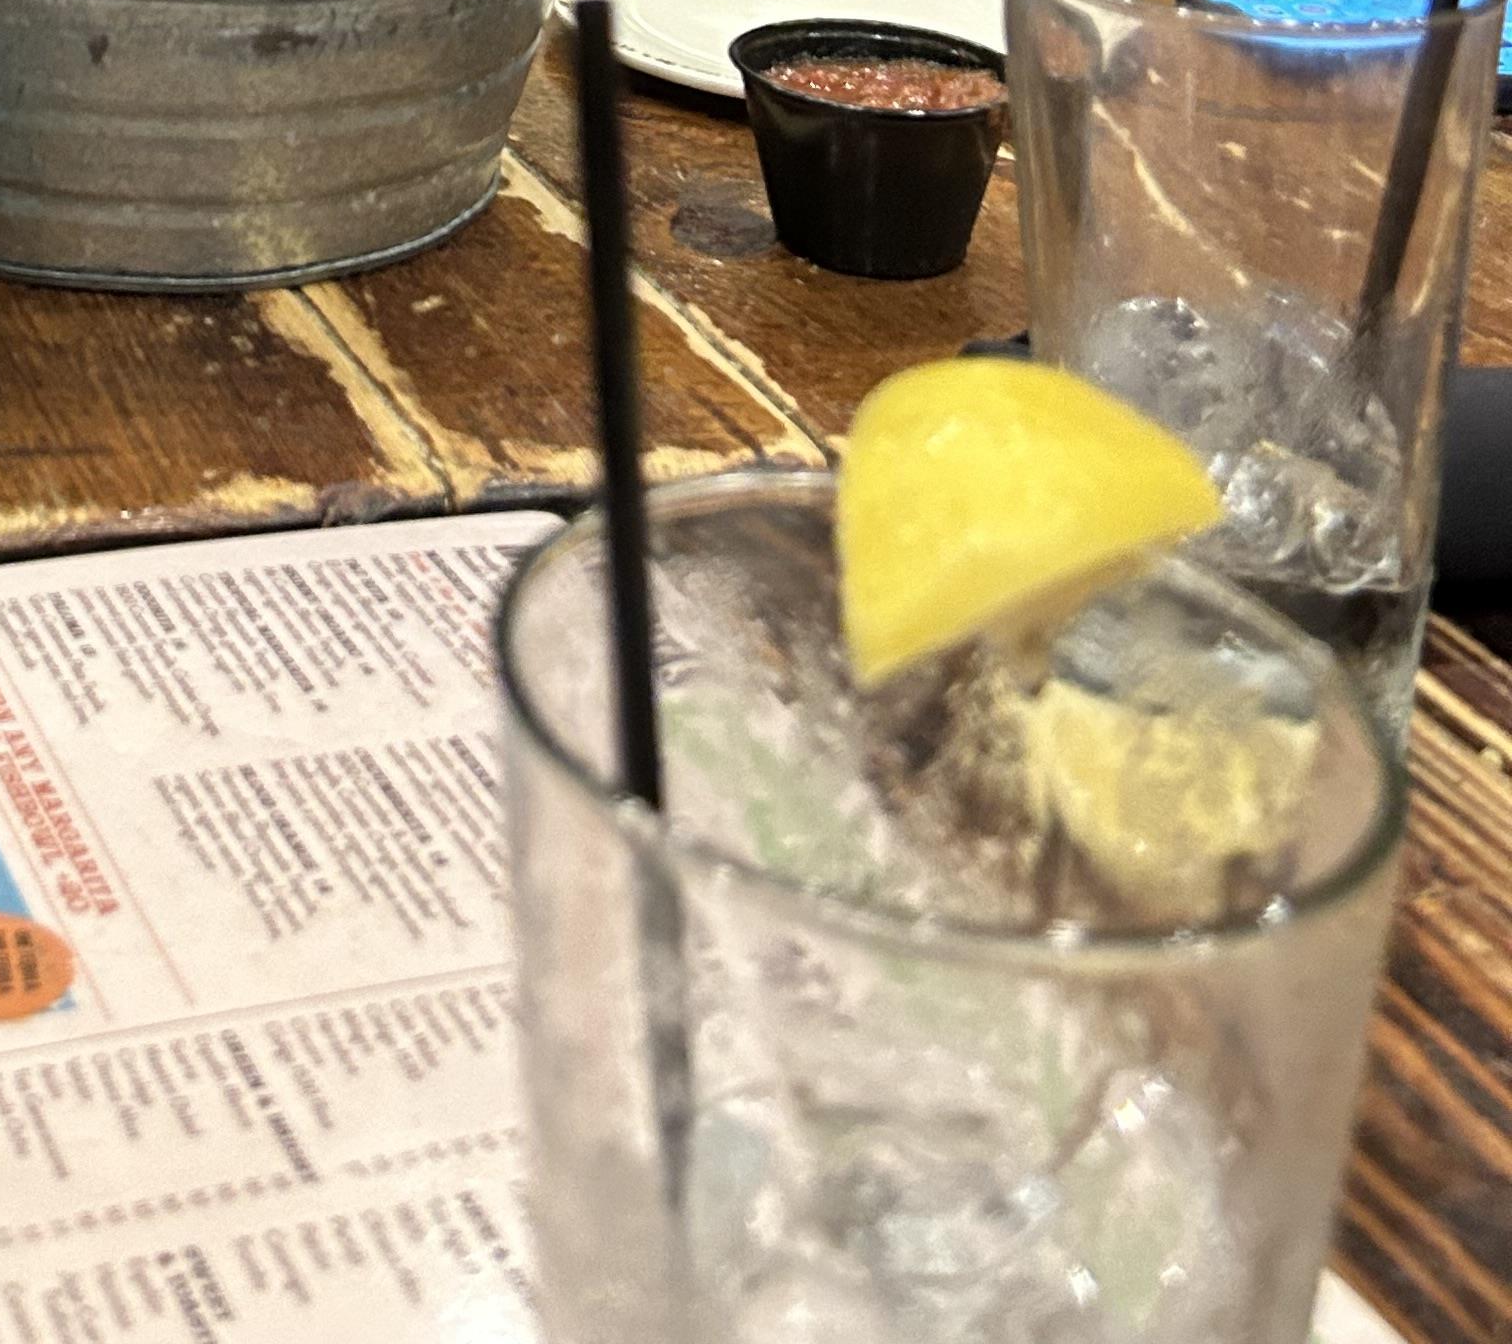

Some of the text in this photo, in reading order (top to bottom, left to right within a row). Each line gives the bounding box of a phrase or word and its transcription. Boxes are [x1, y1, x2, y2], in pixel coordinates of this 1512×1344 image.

[2, 730, 43, 772] ANY
[31, 780, 120, 915] MARGARITA
[220, 1032, 320, 1183] GREEN & BRIGHT
